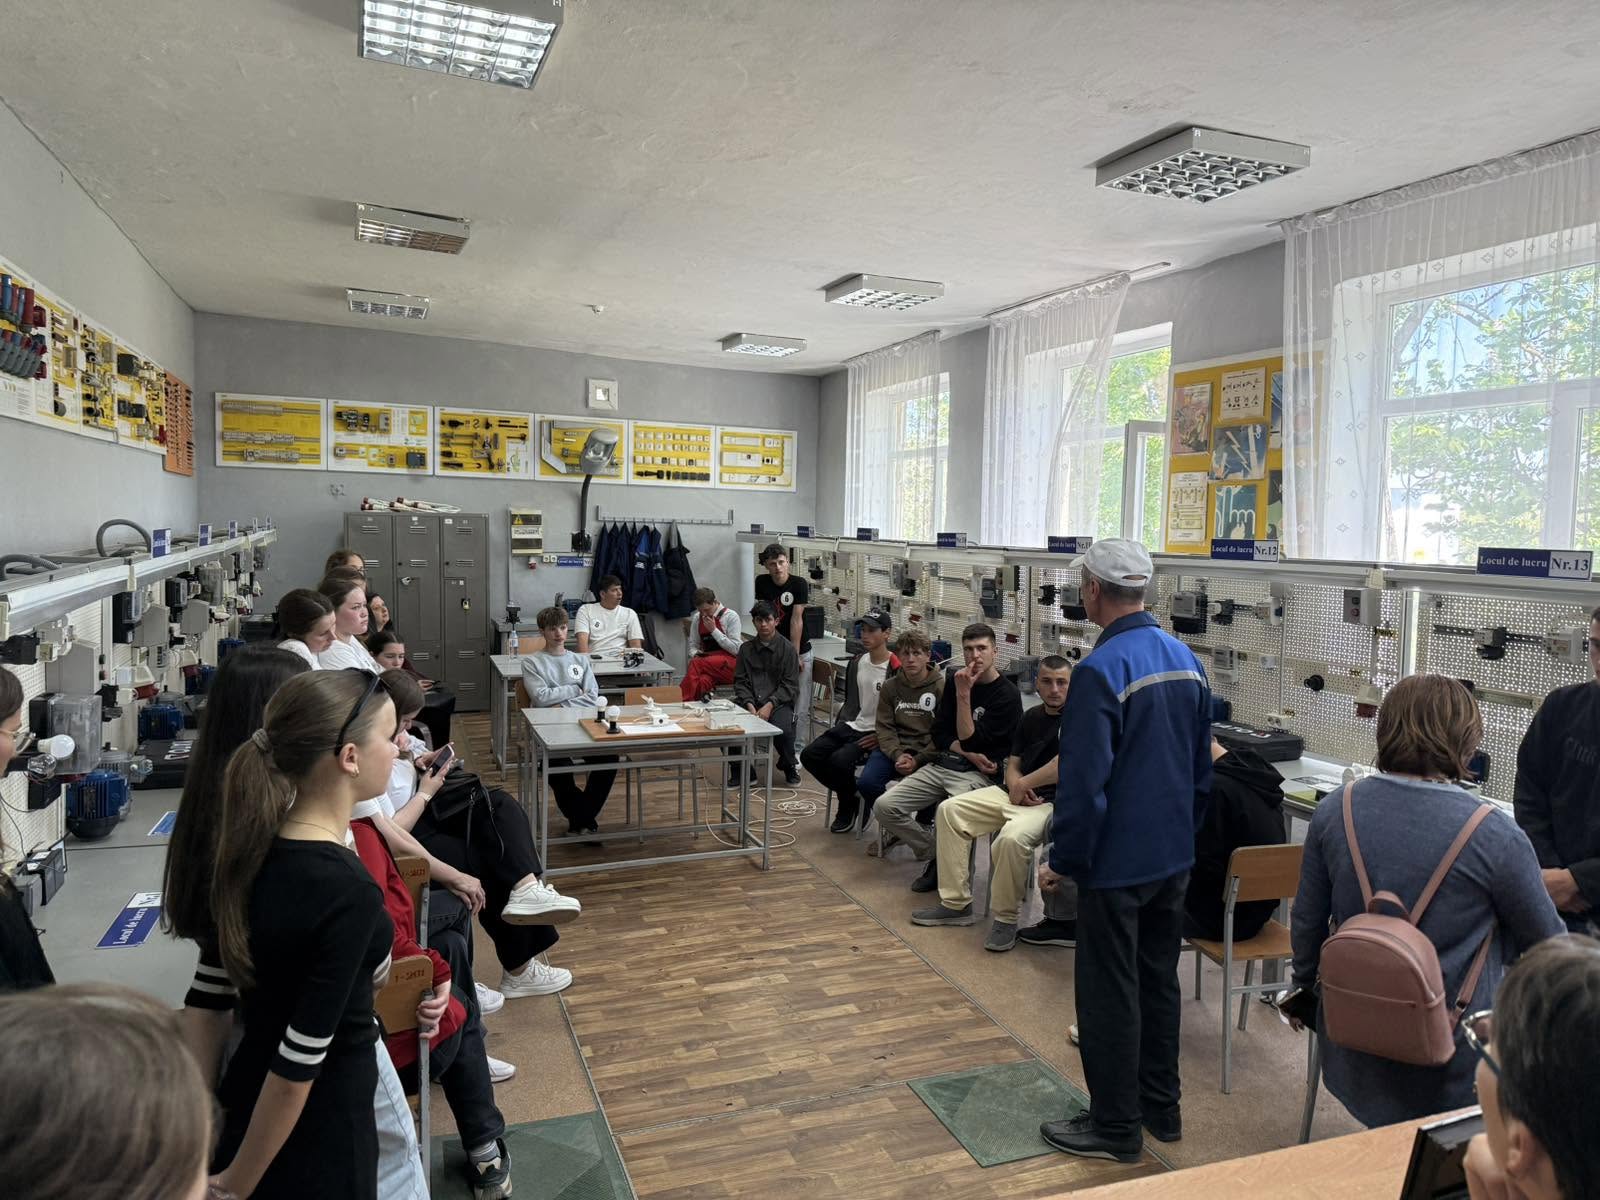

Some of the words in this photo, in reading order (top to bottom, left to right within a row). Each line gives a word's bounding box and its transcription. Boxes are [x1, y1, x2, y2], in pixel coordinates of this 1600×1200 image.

[1212, 545, 1228, 553] Locul
[1255, 546, 1277, 555] Nr.12
[1479, 555, 1505, 566] Locul
[1508, 557, 1520, 566] de
[1521, 557, 1547, 568] lucru
[1551, 557, 1589, 571] Nr.13
[925, 696, 931, 707] 6
